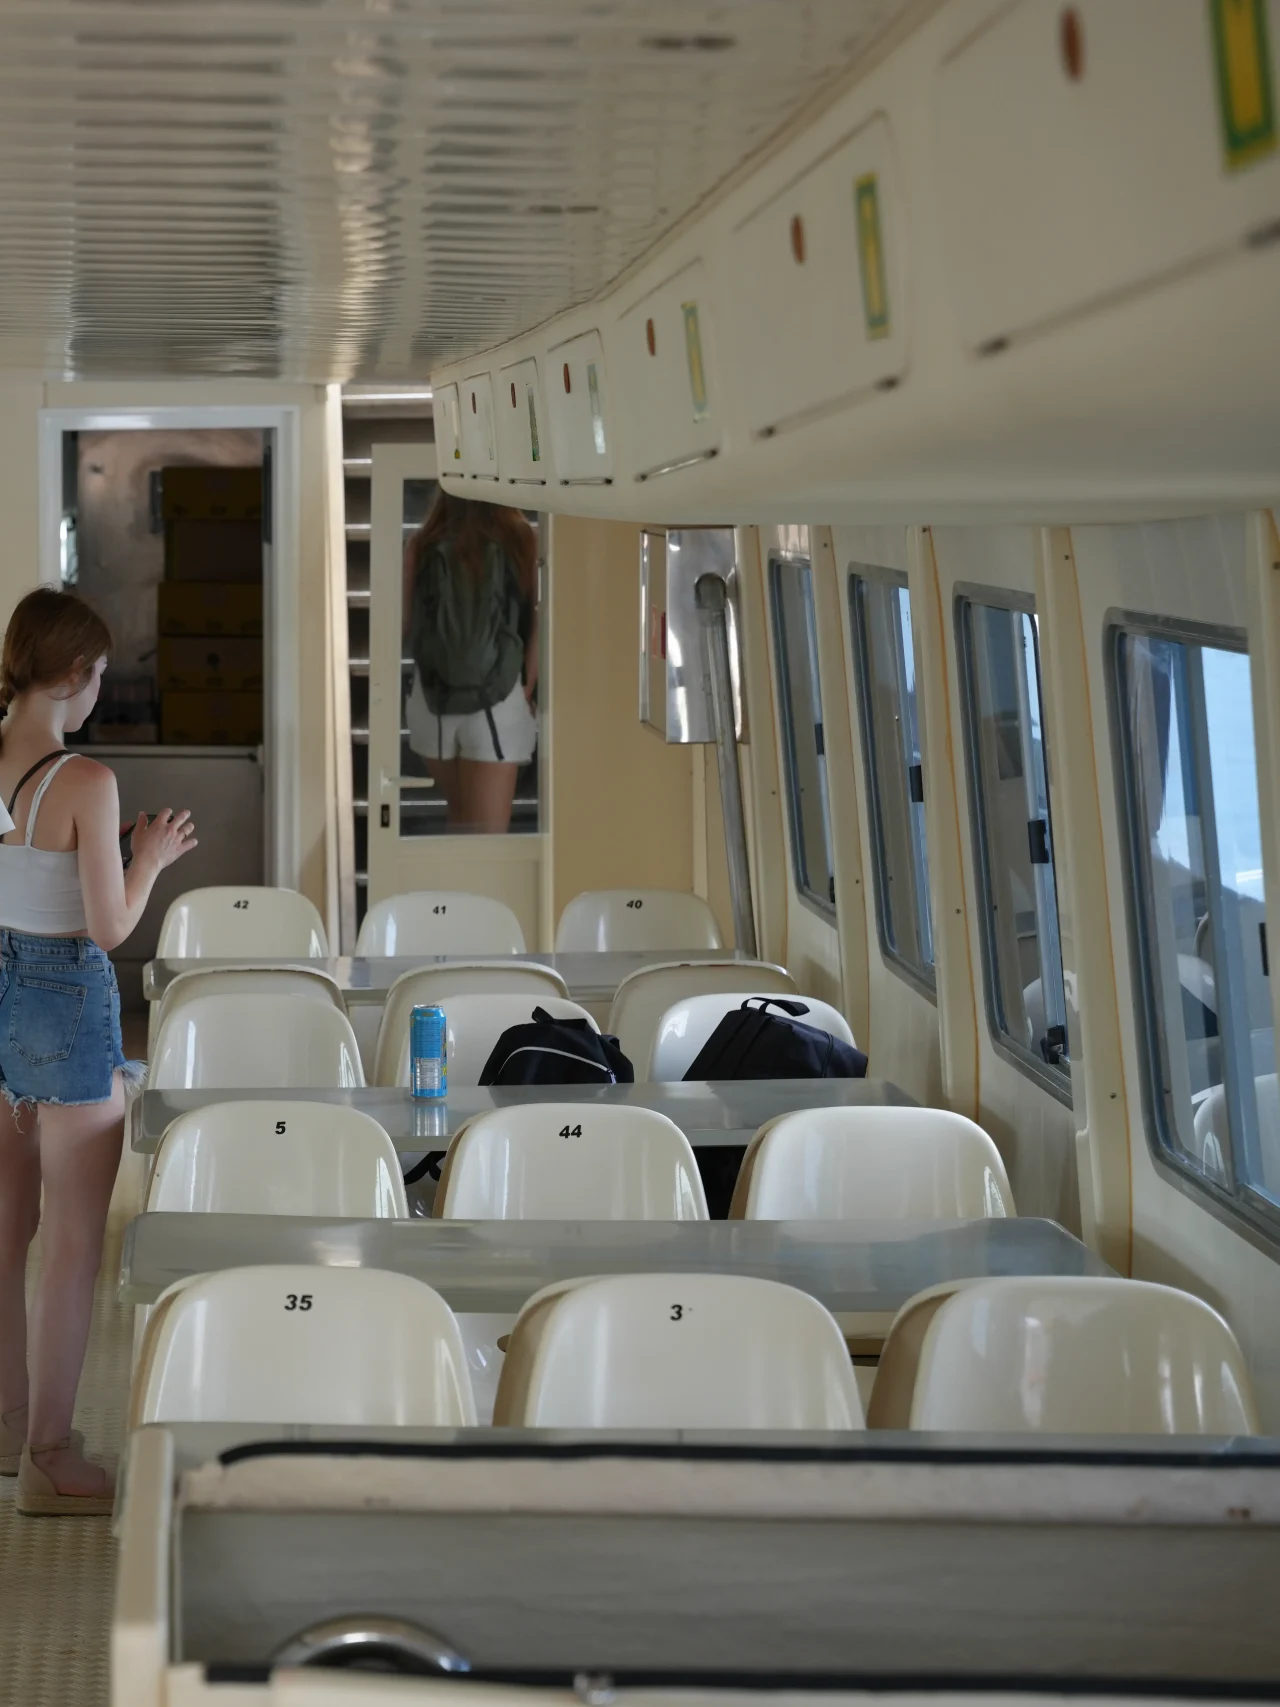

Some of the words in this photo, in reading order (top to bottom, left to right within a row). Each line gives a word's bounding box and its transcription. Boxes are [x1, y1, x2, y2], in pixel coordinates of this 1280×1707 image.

[233, 900, 249, 910] 42
[432, 905, 447, 915] 41
[626, 899, 643, 910] 40
[274, 1121, 287, 1135] 5
[558, 1124, 583, 1139] 44
[284, 1294, 313, 1312] 35
